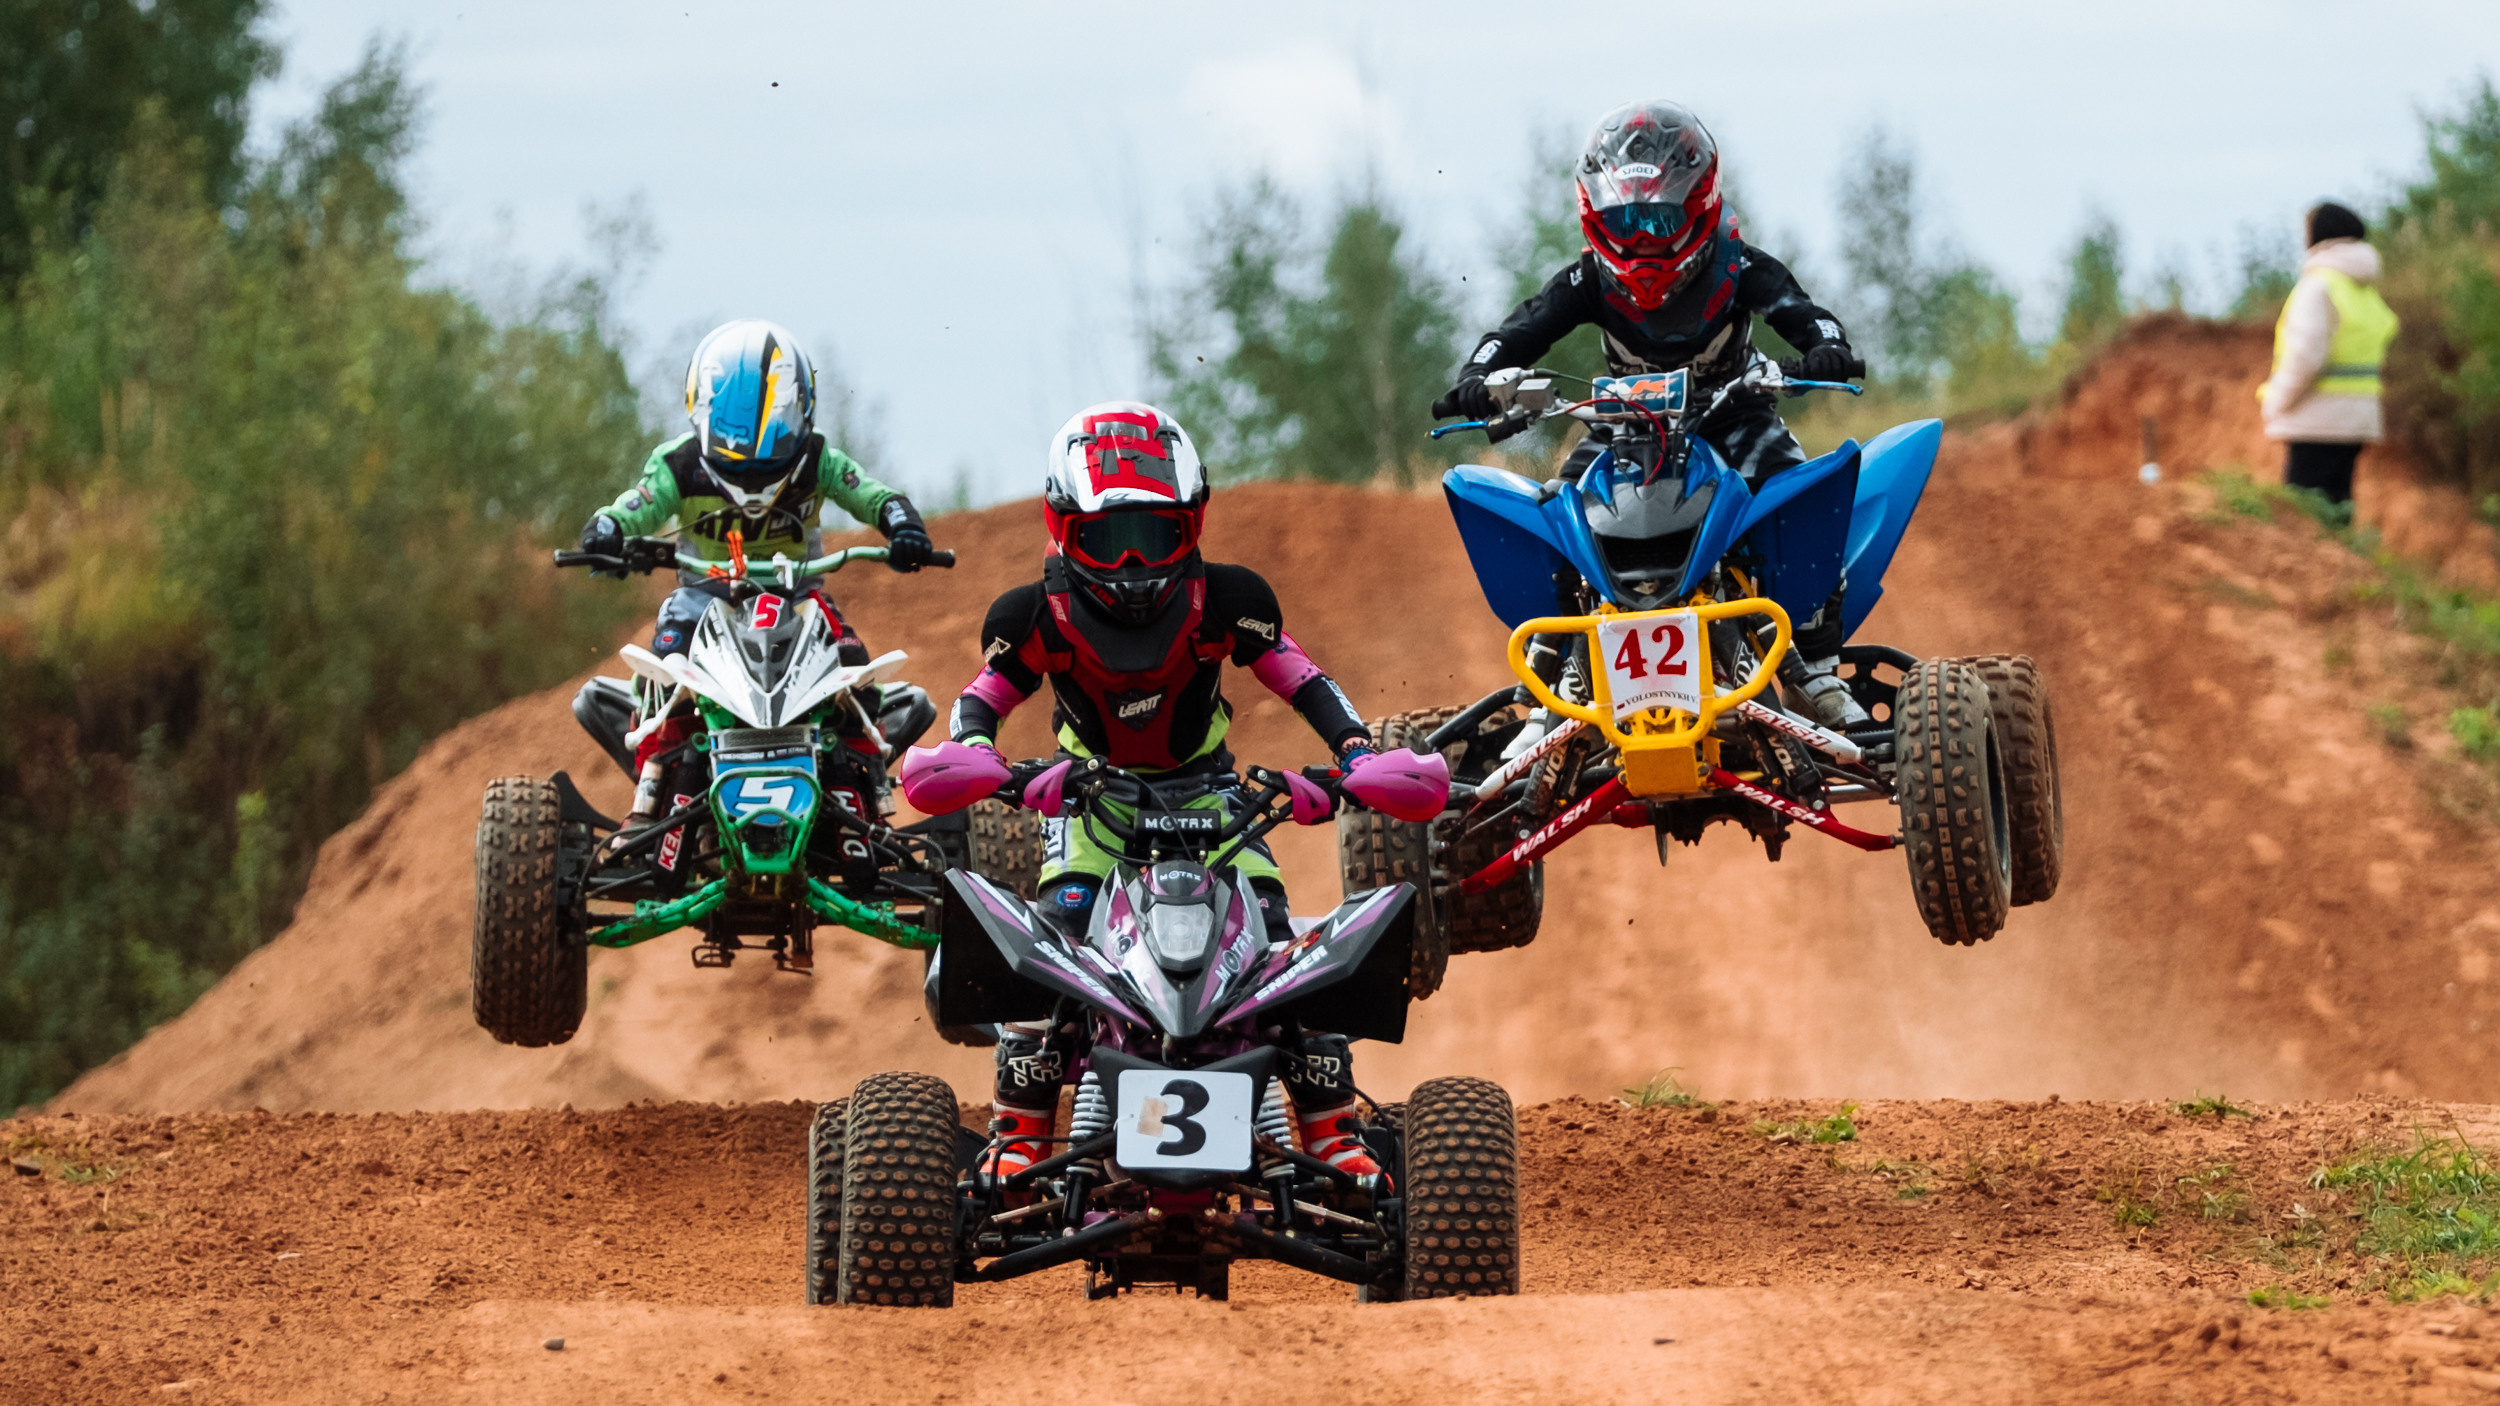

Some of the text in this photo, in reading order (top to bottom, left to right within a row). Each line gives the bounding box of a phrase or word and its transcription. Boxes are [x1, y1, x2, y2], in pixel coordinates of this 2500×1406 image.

[1622, 166, 1654, 176] SHOEI
[750, 591, 784, 631] 5
[1614, 624, 1688, 680] 42
[1733, 640, 1760, 688] OX
[1559, 655, 1590, 706] FOX
[1118, 693, 1162, 718] LEATT
[1737, 700, 1832, 747] WALSH
[1504, 717, 1583, 783] WALSH
[735, 776, 795, 813] 5
[1733, 783, 1826, 825] WALSH
[658, 793, 693, 871] KENA
[1145, 815, 1213, 831] MOTAX
[1513, 797, 1592, 862] WALSH
[1160, 870, 1202, 881] MOTAX
[1034, 940, 1113, 997] SNIPER
[1215, 926, 1254, 983] MOTAX
[1254, 945, 1328, 1001] SNIPER
[1156, 1078, 1210, 1157] 3
